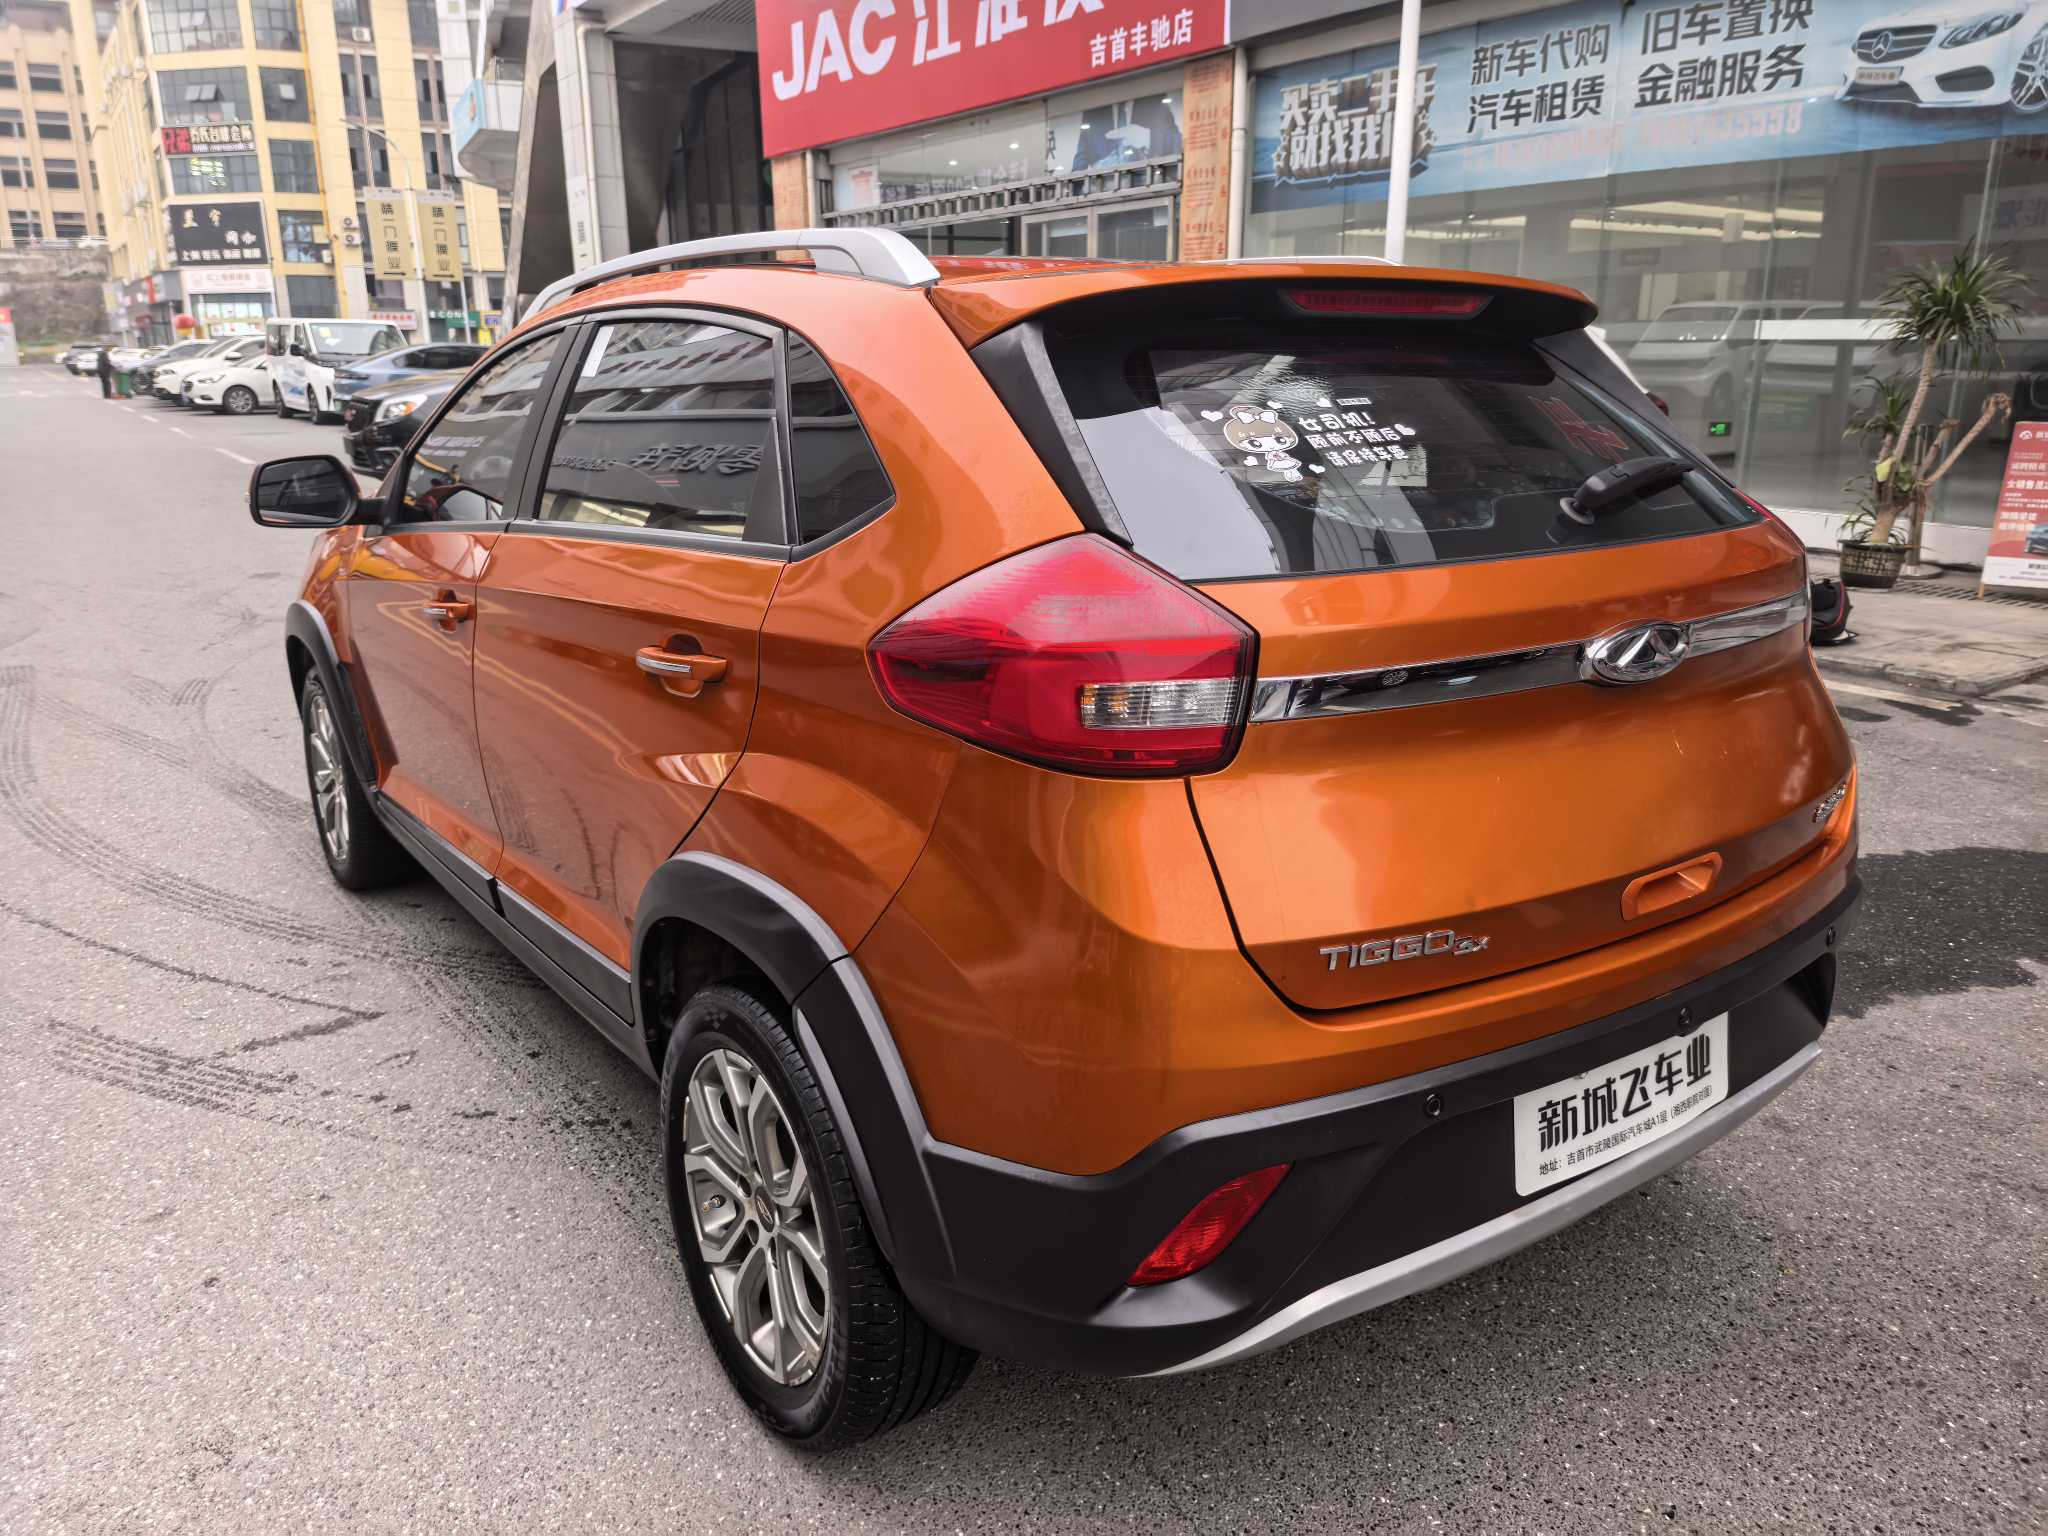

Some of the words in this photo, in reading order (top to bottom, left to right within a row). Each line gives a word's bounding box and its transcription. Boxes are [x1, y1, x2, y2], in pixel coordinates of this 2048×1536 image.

[772, 0, 897, 101] JAC
[912, 0, 1105, 66] 江淮
[1089, 8, 1194, 68] 吉首丰驰店
[1471, 24, 1611, 85] 新车代购
[1641, 0, 1815, 55] 旧车置换
[1467, 74, 1605, 133] 汽车租赁
[1634, 44, 1807, 108] 金融服务
[1305, 428, 1400, 448] 顾前不顾后
[1325, 445, 1408, 467] 请保持车距
[1538, 1033, 1711, 1153] 新城飞车业
